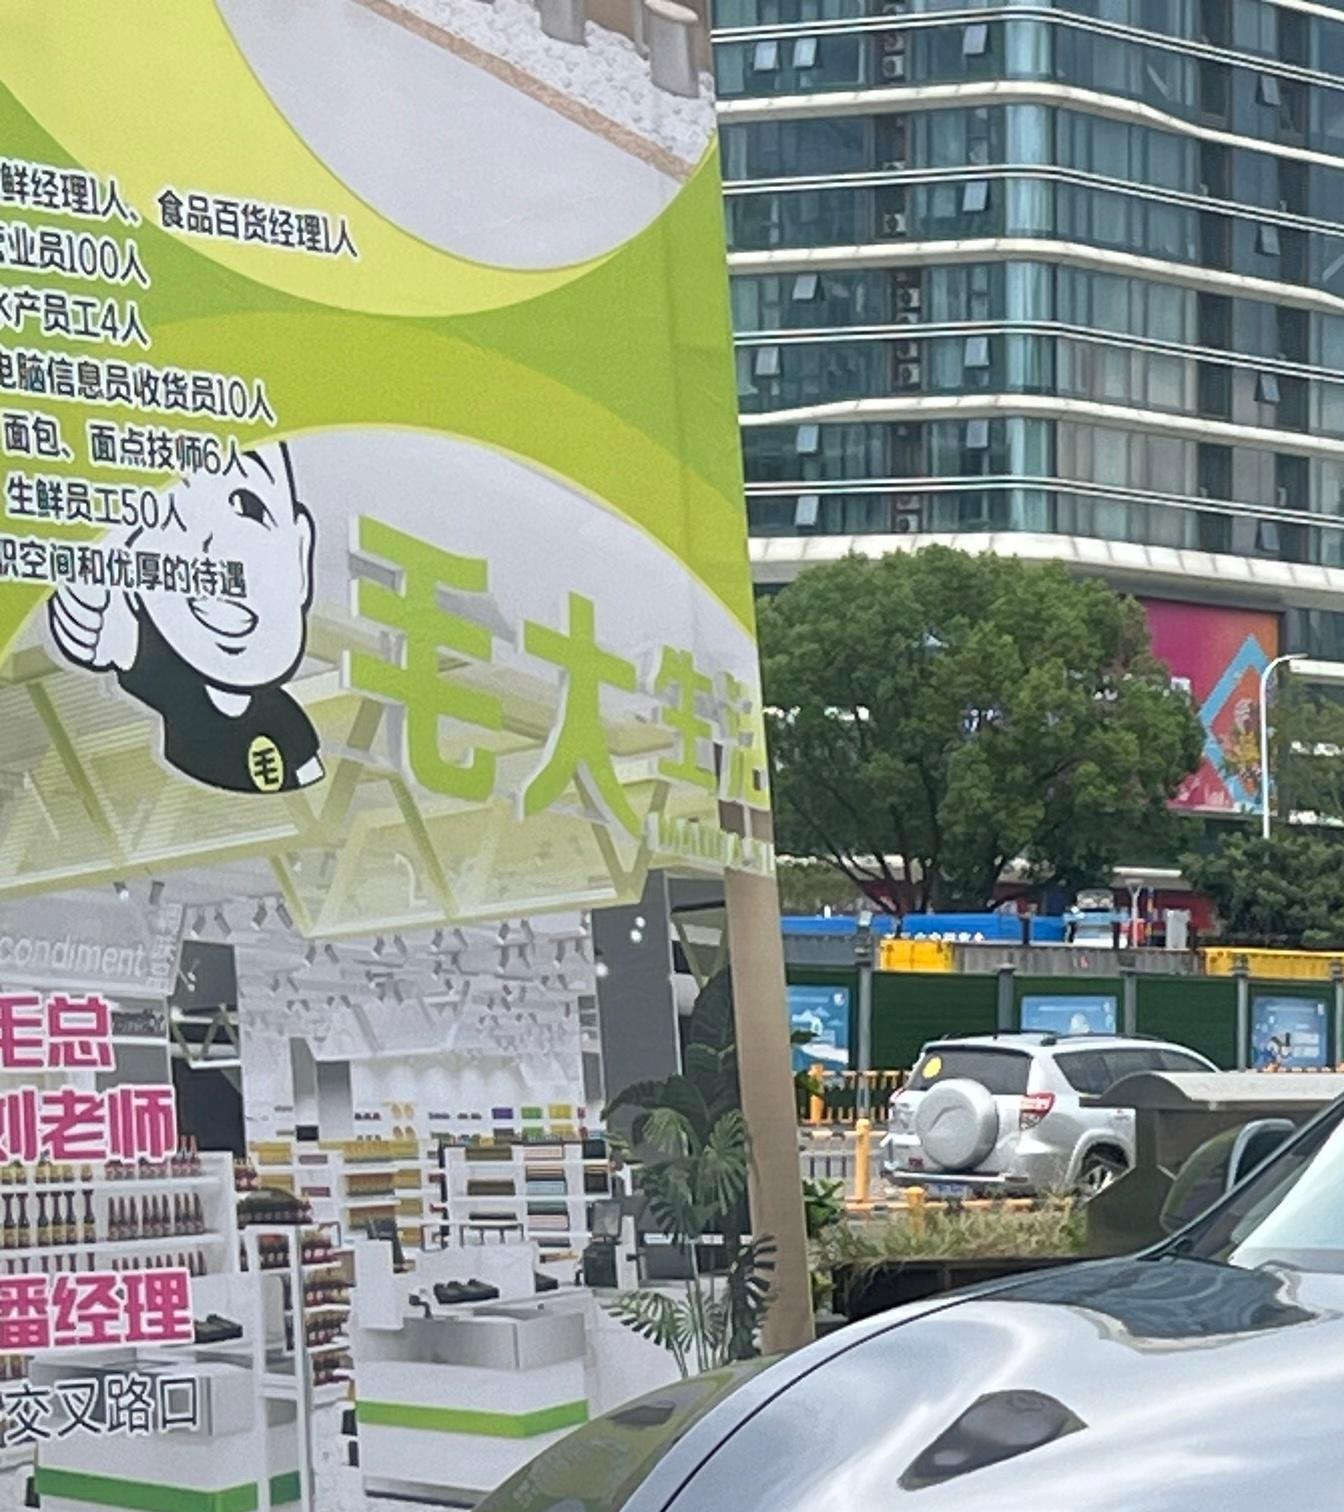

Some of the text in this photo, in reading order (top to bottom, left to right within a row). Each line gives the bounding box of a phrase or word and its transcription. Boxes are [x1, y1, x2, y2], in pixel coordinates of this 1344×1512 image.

[0, 225, 147, 285] 业员100人
[8, 475, 187, 532] 生鲜员工50人
[253, 747, 279, 785] 毛
[0, 934, 146, 978] condiment
[5, 1377, 197, 1439] 交叉路口
